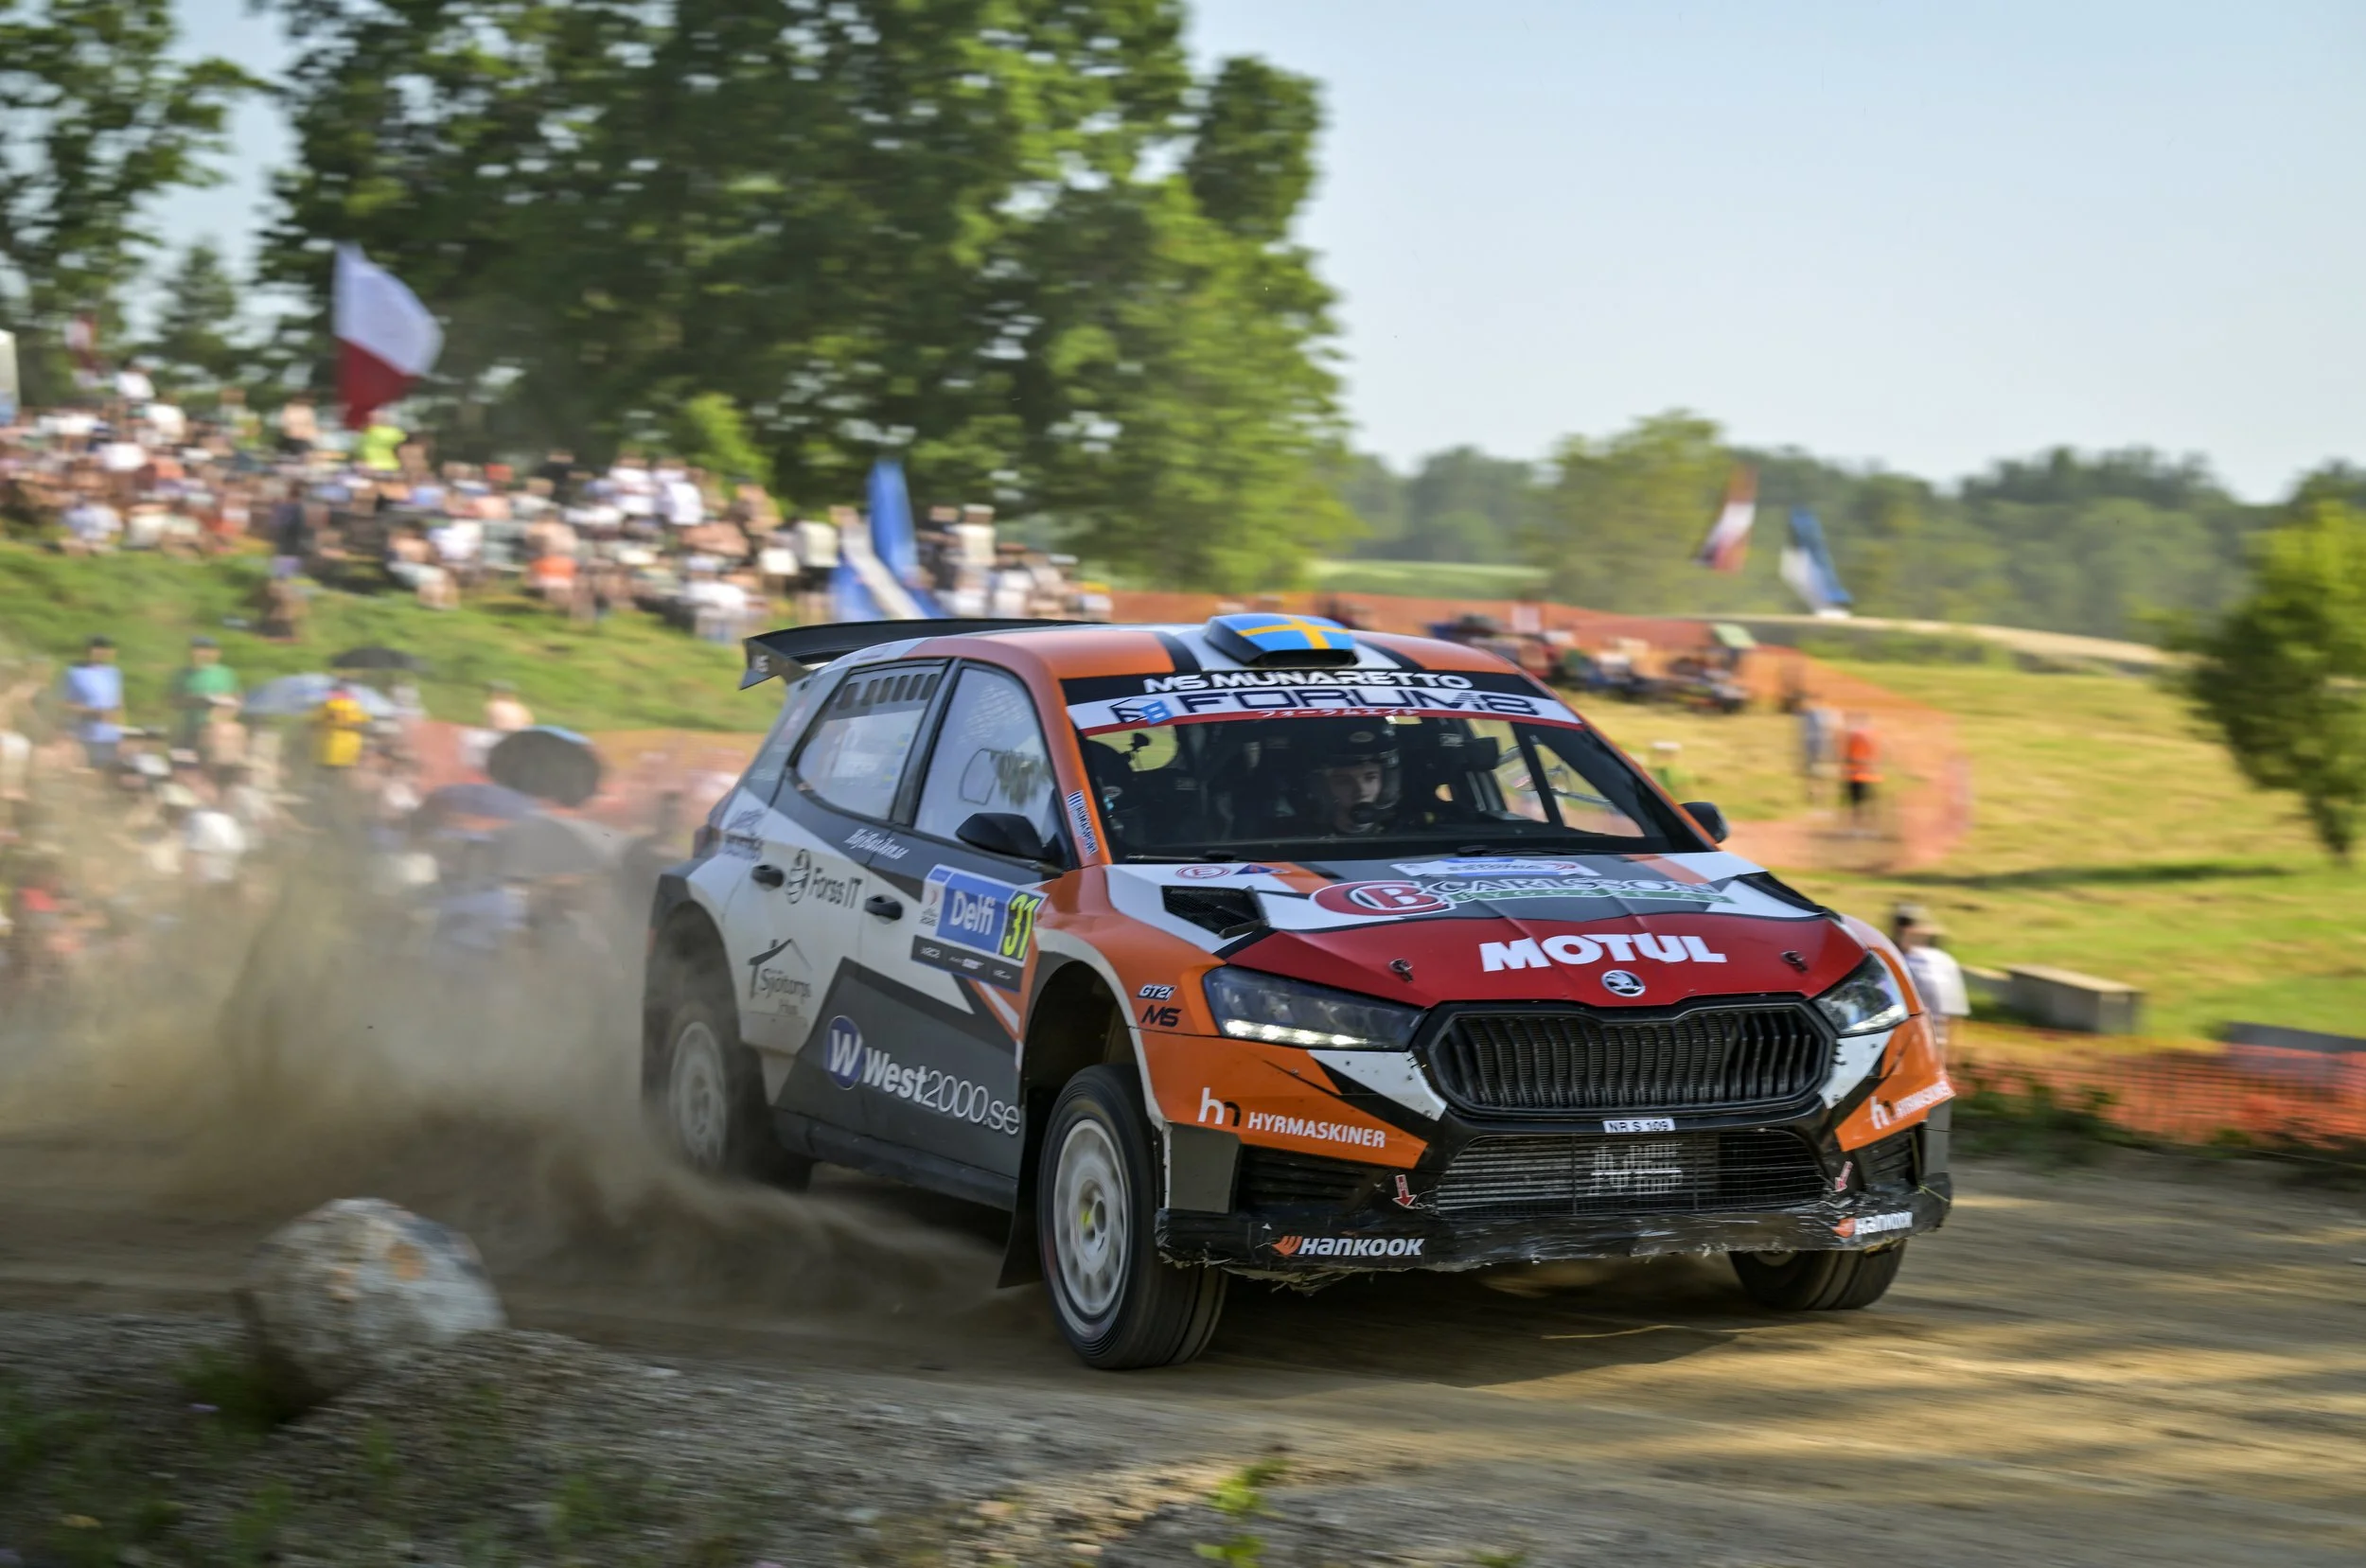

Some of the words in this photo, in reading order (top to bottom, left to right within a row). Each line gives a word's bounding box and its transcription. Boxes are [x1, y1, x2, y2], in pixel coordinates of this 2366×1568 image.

[1143, 675, 1209, 694] MS
[1211, 670, 1474, 689] MUNARETTO
[1176, 689, 1540, 715] FORUM8
[1422, 876, 1721, 896] CARLSSON
[949, 890, 996, 935] Delfi
[1003, 894, 1040, 960] 31
[1479, 933, 1728, 972] MOTUL
[1140, 1005, 1182, 1028] MS
[863, 1047, 1021, 1136] West2000.se
[1247, 1112, 1386, 1149] HYRMASKINER
[1609, 1121, 1628, 1133] NR
[1633, 1121, 1642, 1132] S
[1647, 1120, 1669, 1131] 109
